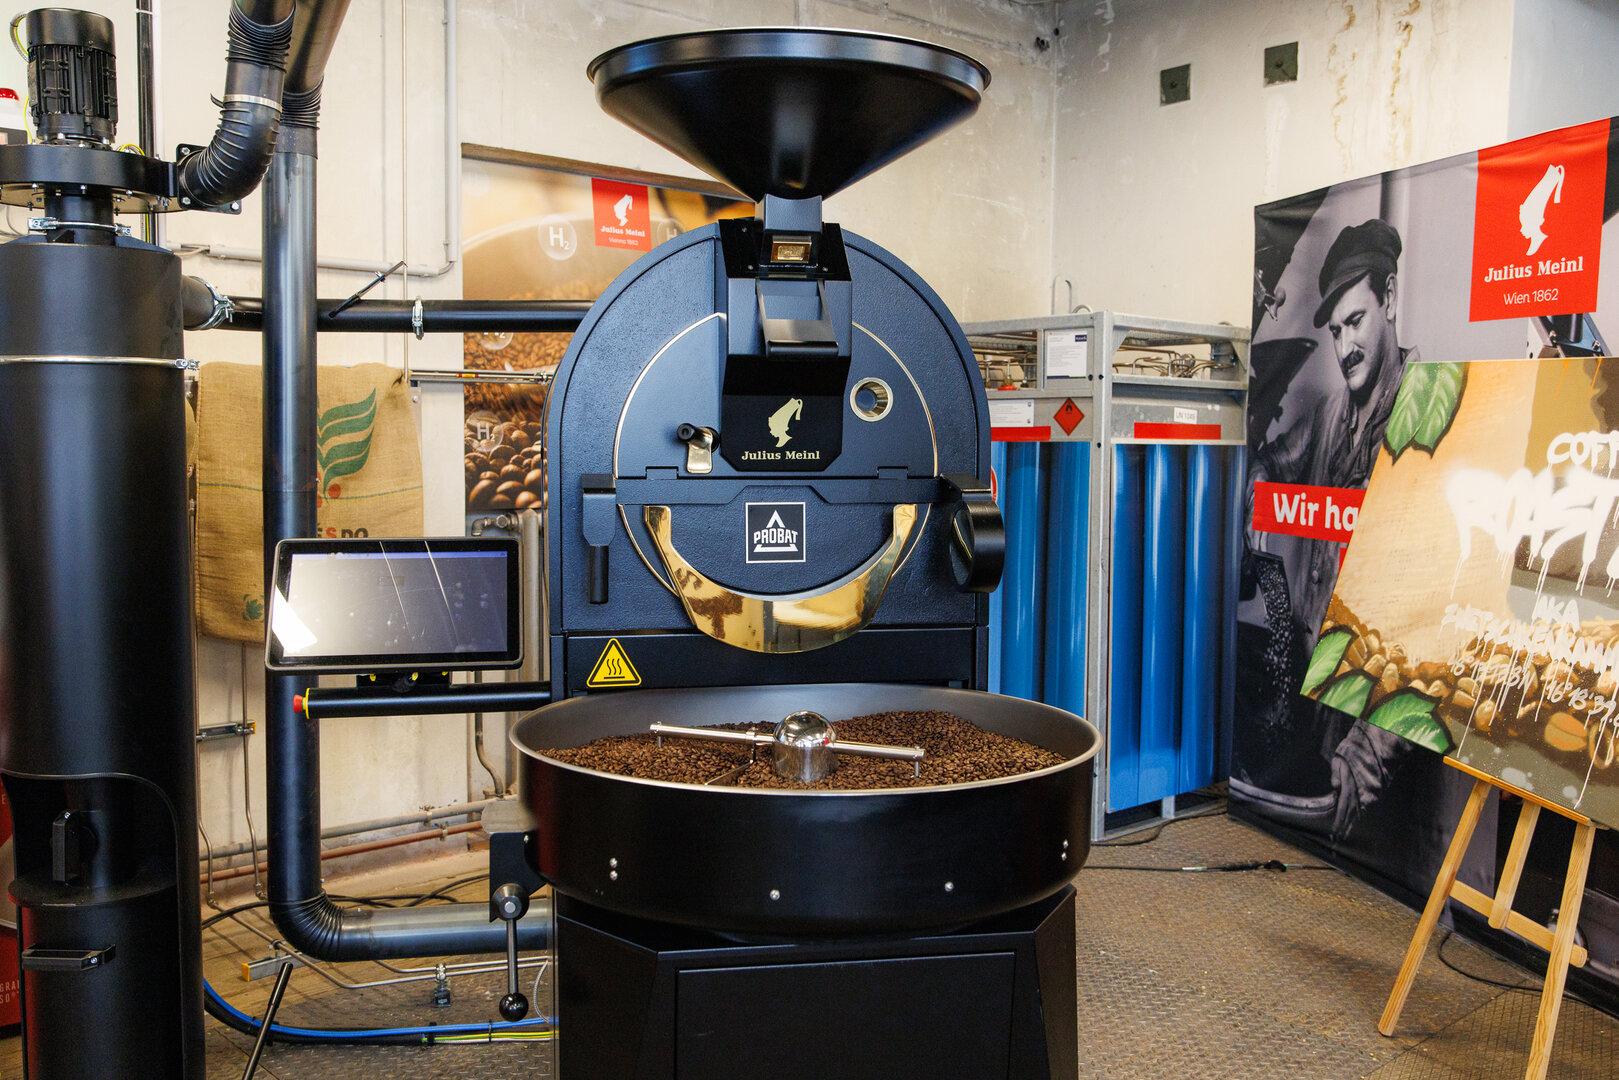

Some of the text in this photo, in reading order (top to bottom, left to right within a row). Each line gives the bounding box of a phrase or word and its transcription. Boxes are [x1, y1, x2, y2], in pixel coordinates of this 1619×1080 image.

[1484, 256, 1584, 283] Julius Meinl
[1503, 288, 1559, 306] Wien 1862
[741, 450, 820, 460] Julius Meinl
[1273, 492, 1319, 527] Wir
[753, 528, 798, 544] PROBAT
[1532, 596, 1580, 632] AKA
